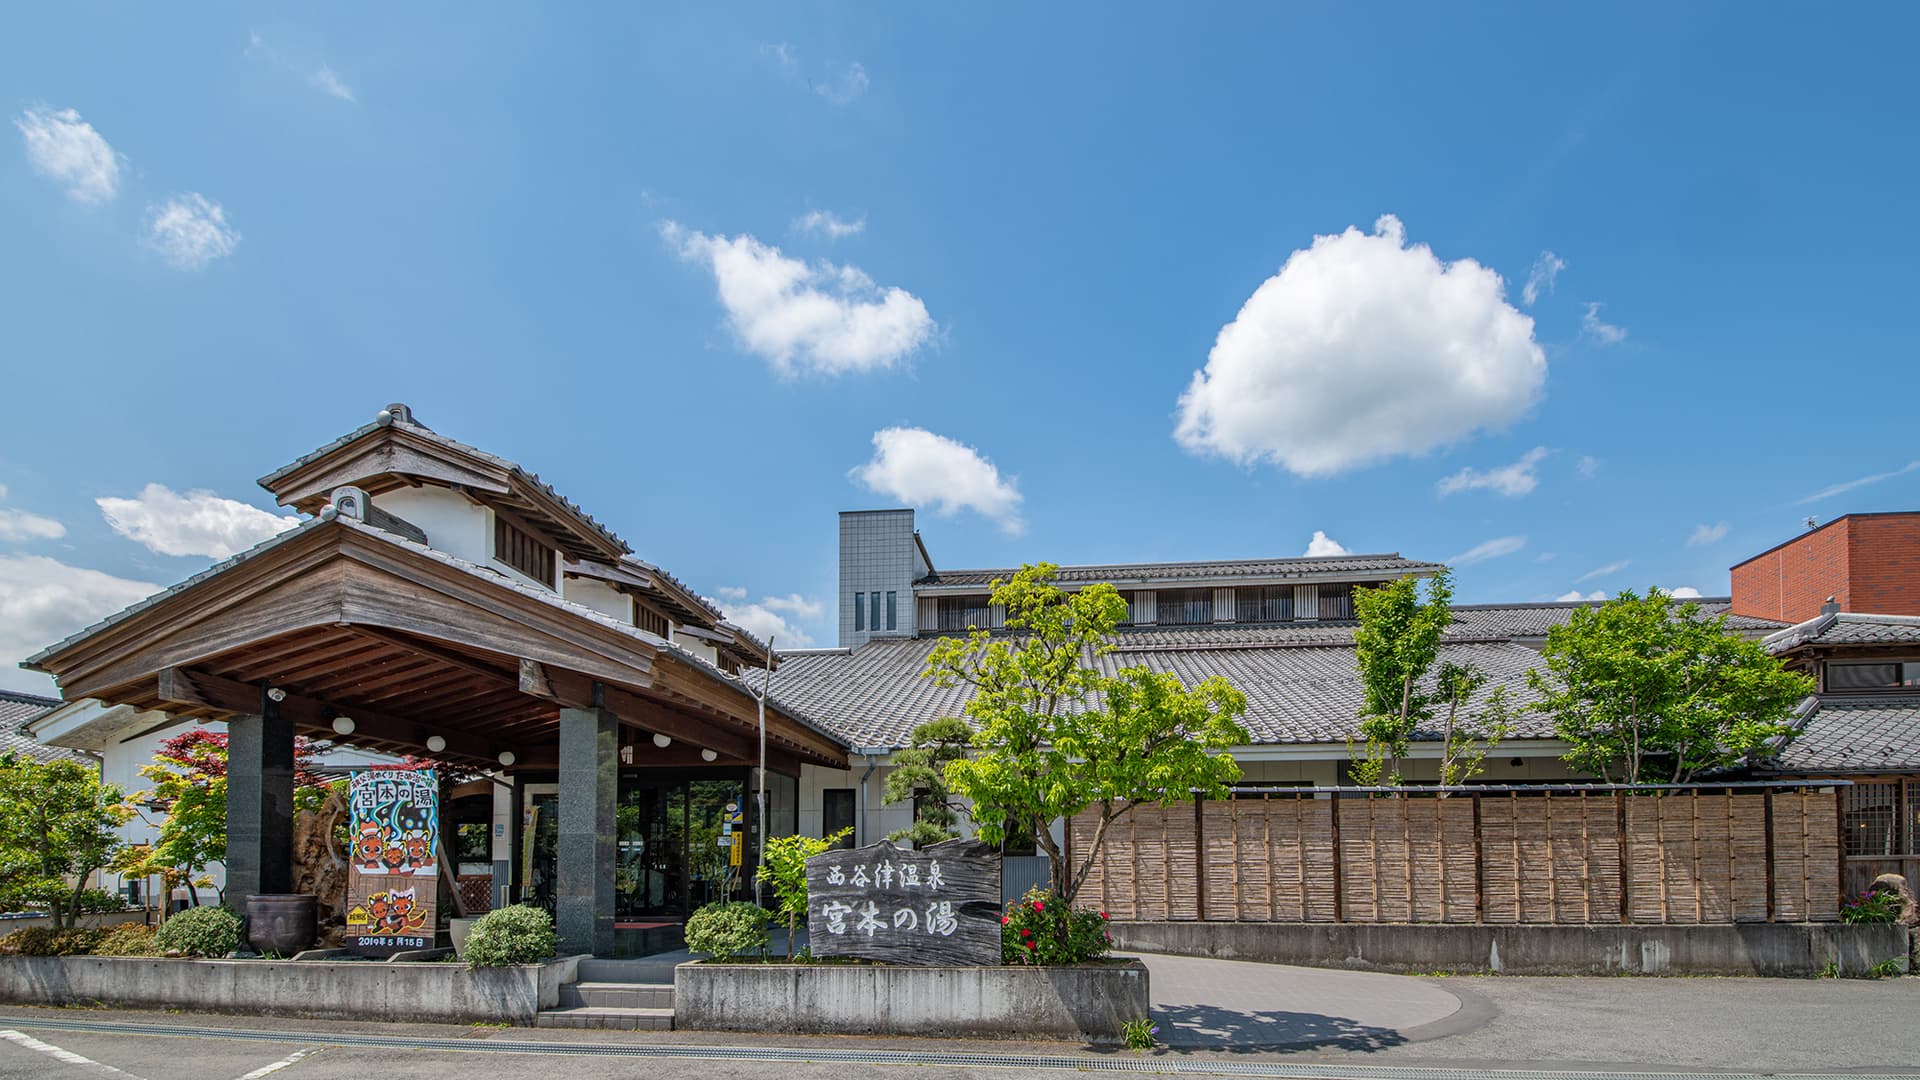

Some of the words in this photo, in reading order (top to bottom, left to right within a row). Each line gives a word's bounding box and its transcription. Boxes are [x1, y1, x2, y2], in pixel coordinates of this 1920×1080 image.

[358, 785, 432, 806] 宮本の湯
[826, 859, 945, 890] 西谷津温泉
[822, 900, 959, 937] 宮本の湯
